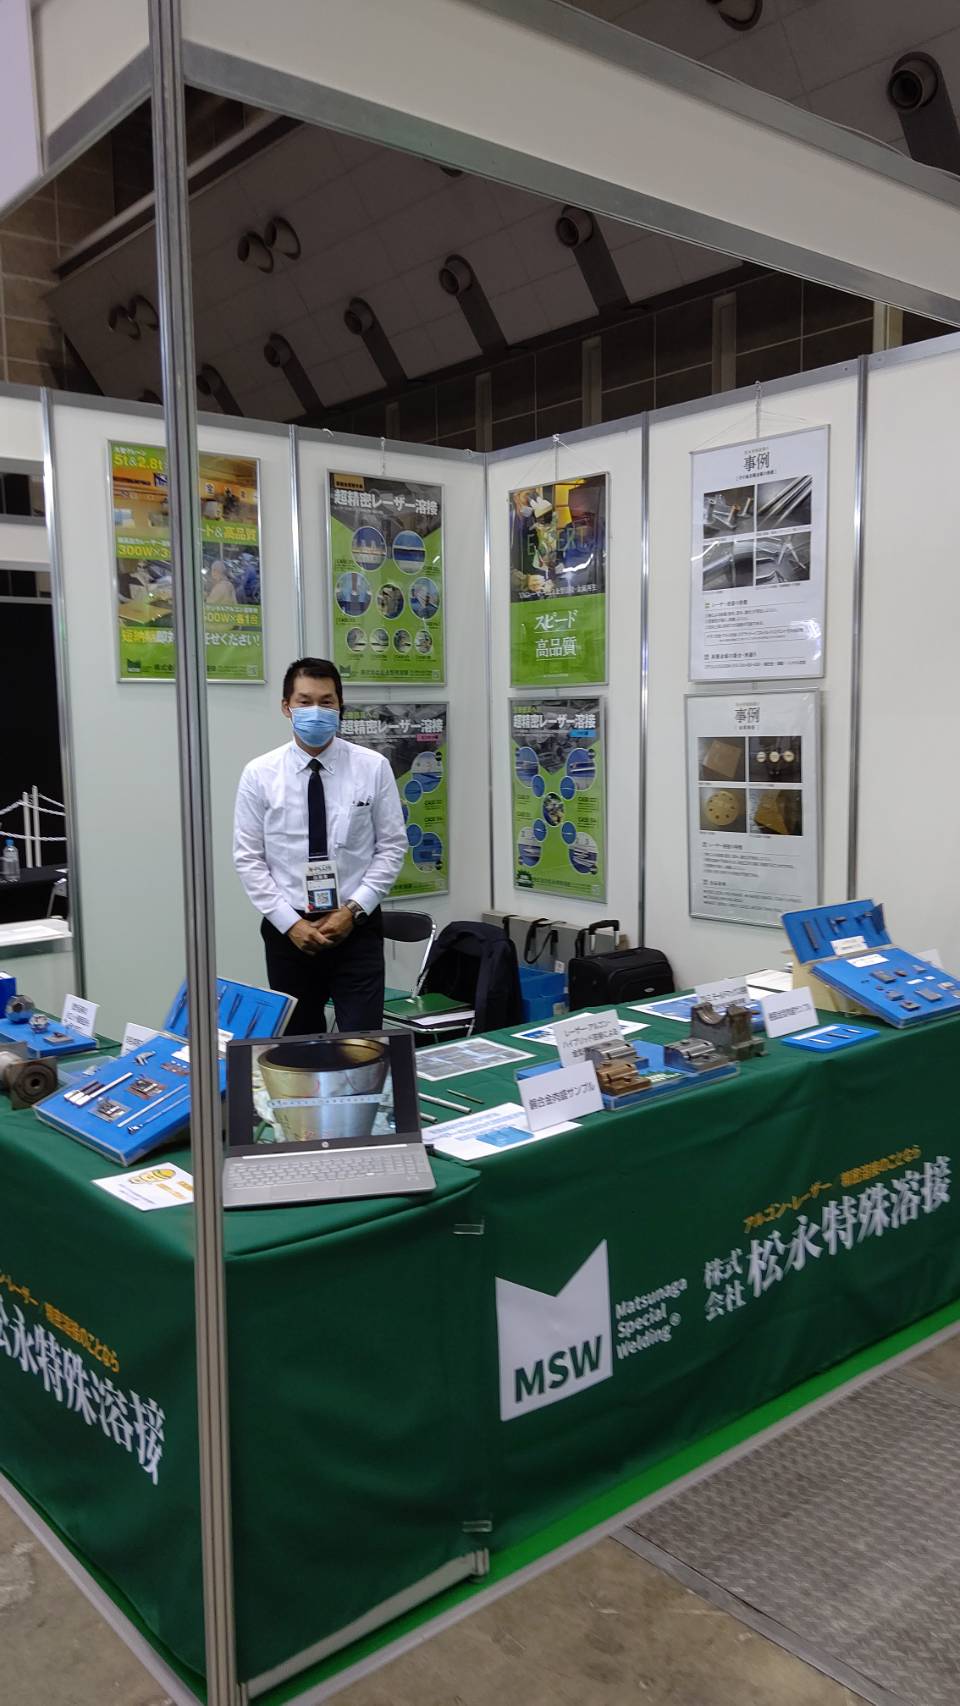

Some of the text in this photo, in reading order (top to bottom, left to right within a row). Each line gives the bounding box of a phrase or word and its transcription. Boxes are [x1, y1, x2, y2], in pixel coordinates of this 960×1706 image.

[743, 451, 770, 472] 事例
[334, 488, 438, 515] 超精密レーザー溶接
[534, 609, 578, 631] スピード
[535, 636, 577, 658] 高品質
[341, 719, 443, 735] 超精密レーザー溶接
[513, 713, 596, 729] 超精密レーザー溶接
[735, 707, 761, 723] 事例
[747, 1155, 952, 1298] 松永特殊溶接
[703, 1248, 743, 1290] 株式
[615, 1277, 688, 1319] Matsunaga
[704, 1280, 747, 1322] 会社
[616, 1303, 668, 1339] Special
[616, 1325, 673, 1360] Welding
[514, 1334, 603, 1404] MSW
